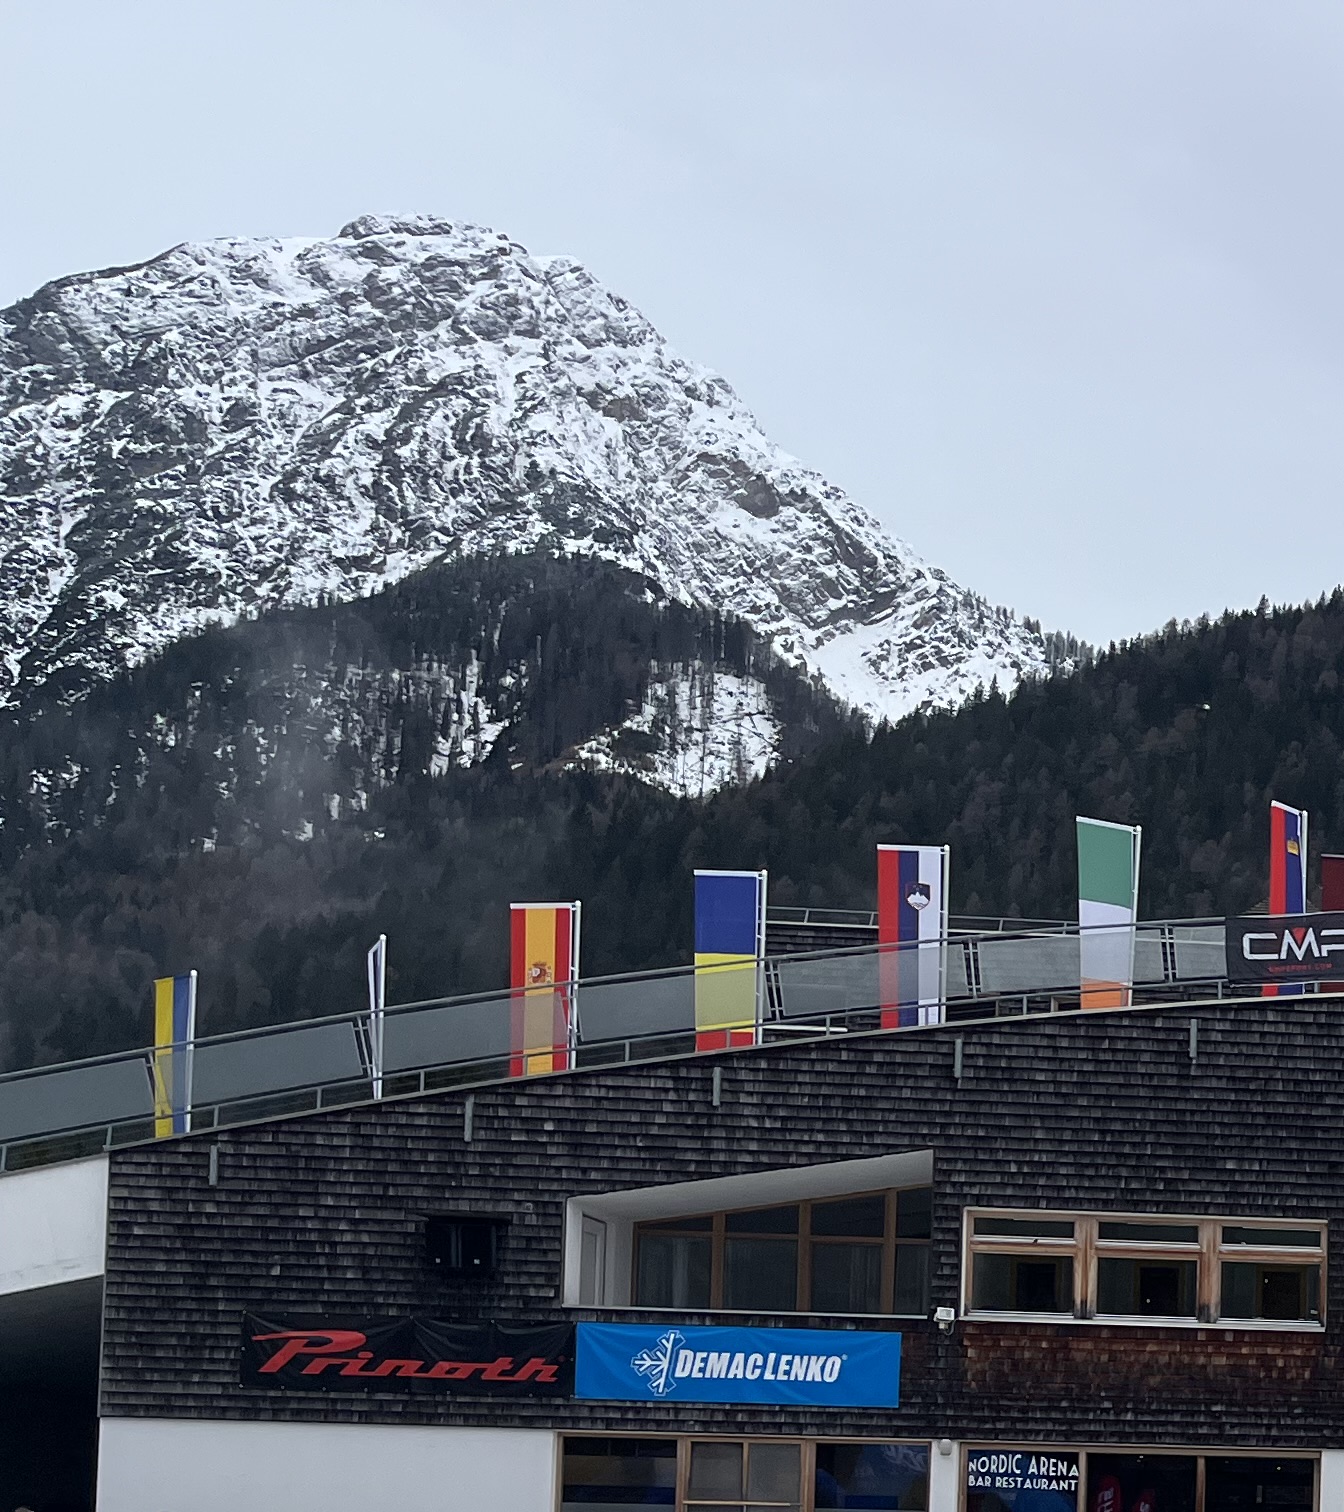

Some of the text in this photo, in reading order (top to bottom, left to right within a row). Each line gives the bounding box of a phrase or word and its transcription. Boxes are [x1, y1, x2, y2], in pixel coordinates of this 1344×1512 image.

[252, 1329, 559, 1383] Prinoth
[673, 1348, 842, 1384] DEMACLENKO
[968, 1453, 1080, 1477] NORDIC ARENA
[968, 1475, 1078, 1491] BAR RESTAURANT
